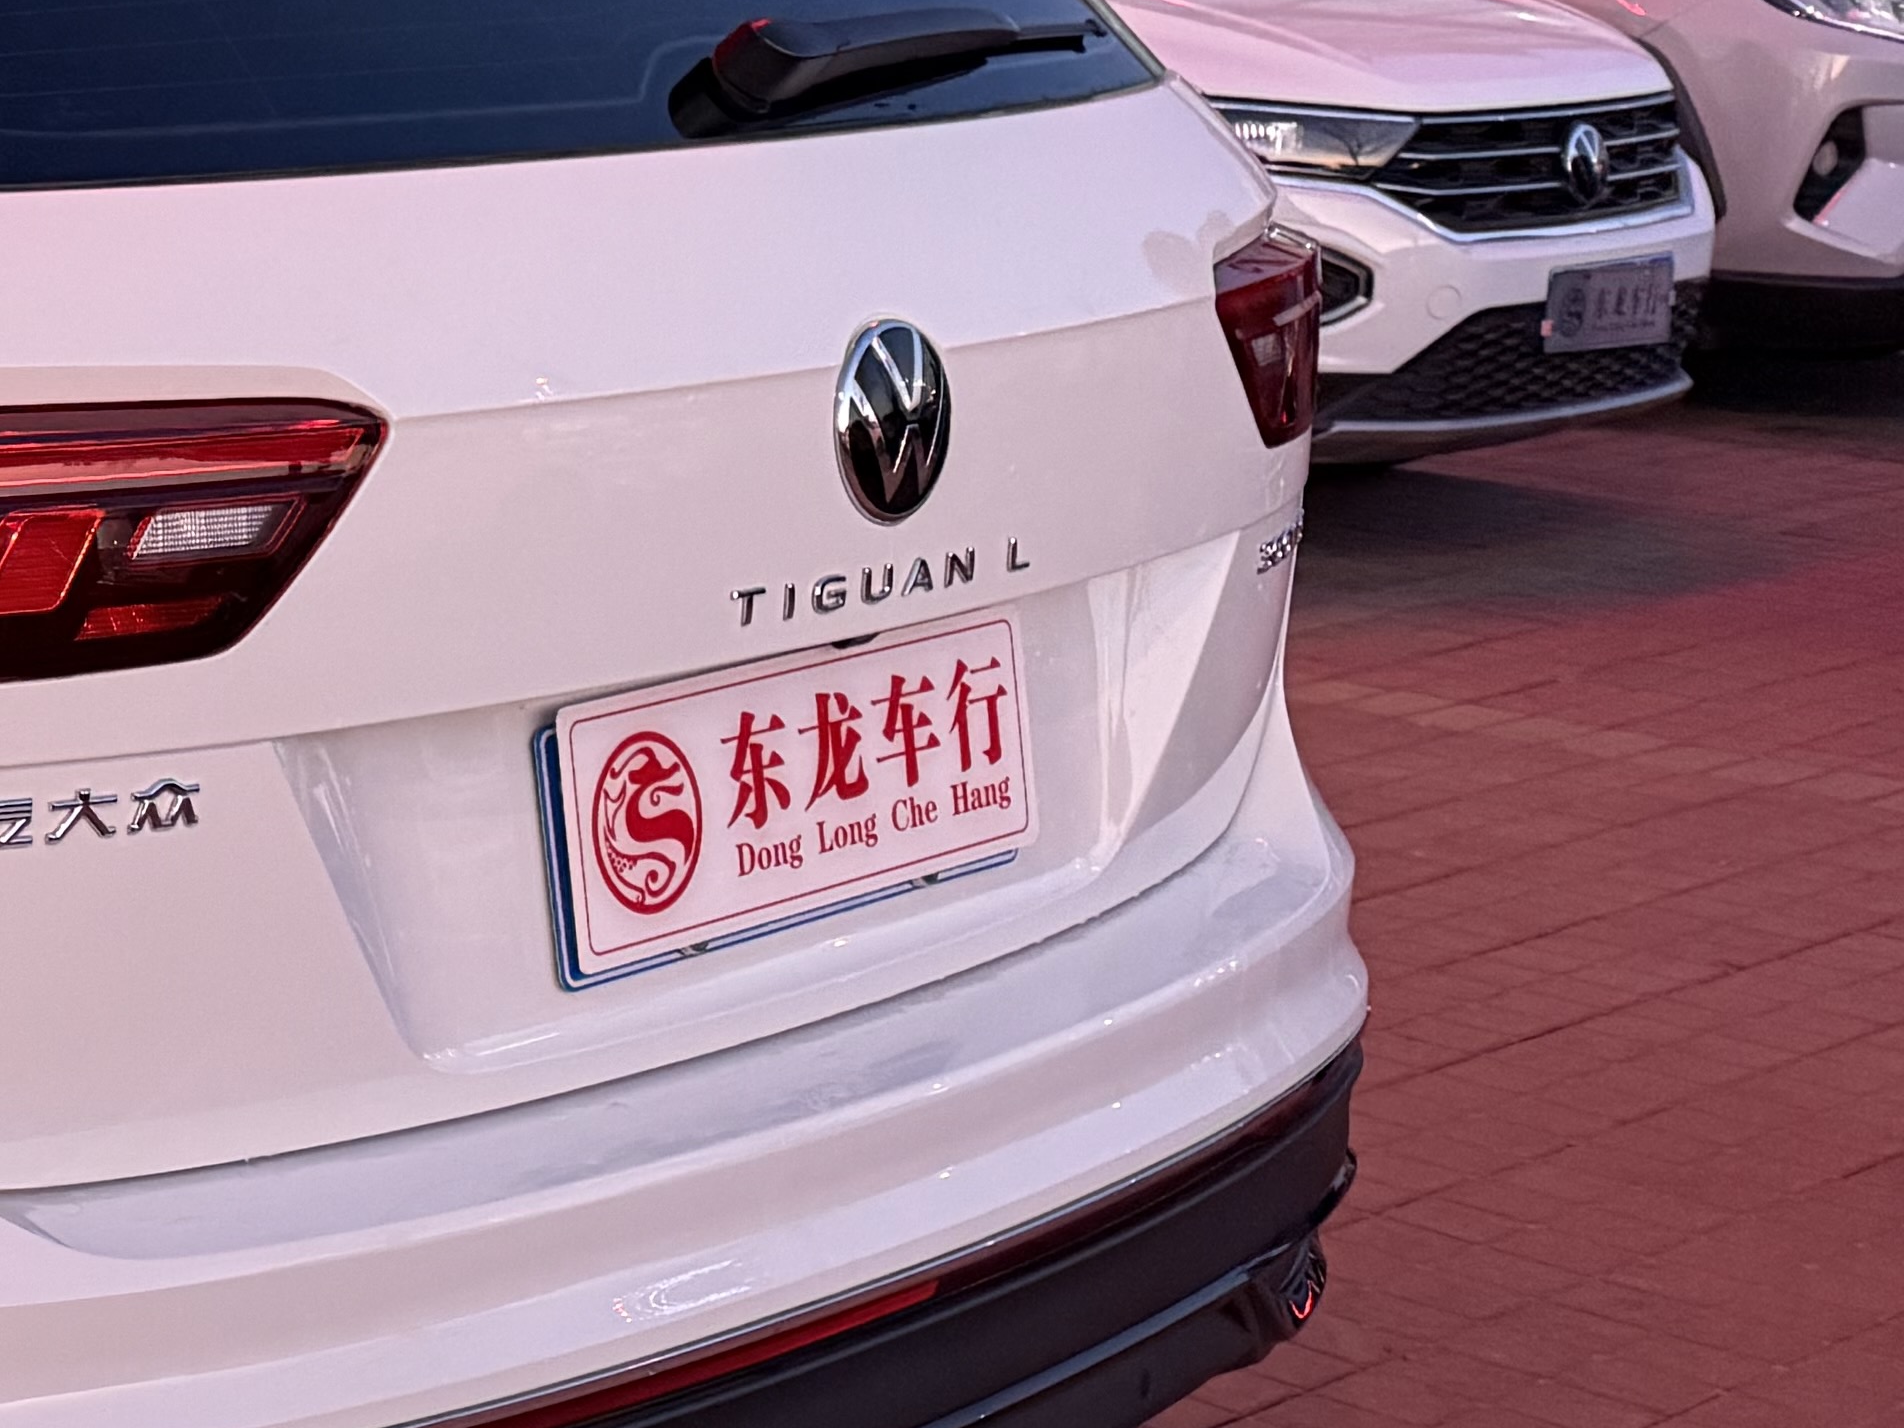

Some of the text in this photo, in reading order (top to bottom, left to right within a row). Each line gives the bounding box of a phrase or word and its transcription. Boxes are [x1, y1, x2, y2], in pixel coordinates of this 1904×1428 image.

[730, 536, 1032, 628] TIGUAN L
[720, 656, 1009, 830] 东龙车行
[735, 776, 1012, 877] Dong Long Che Hang
